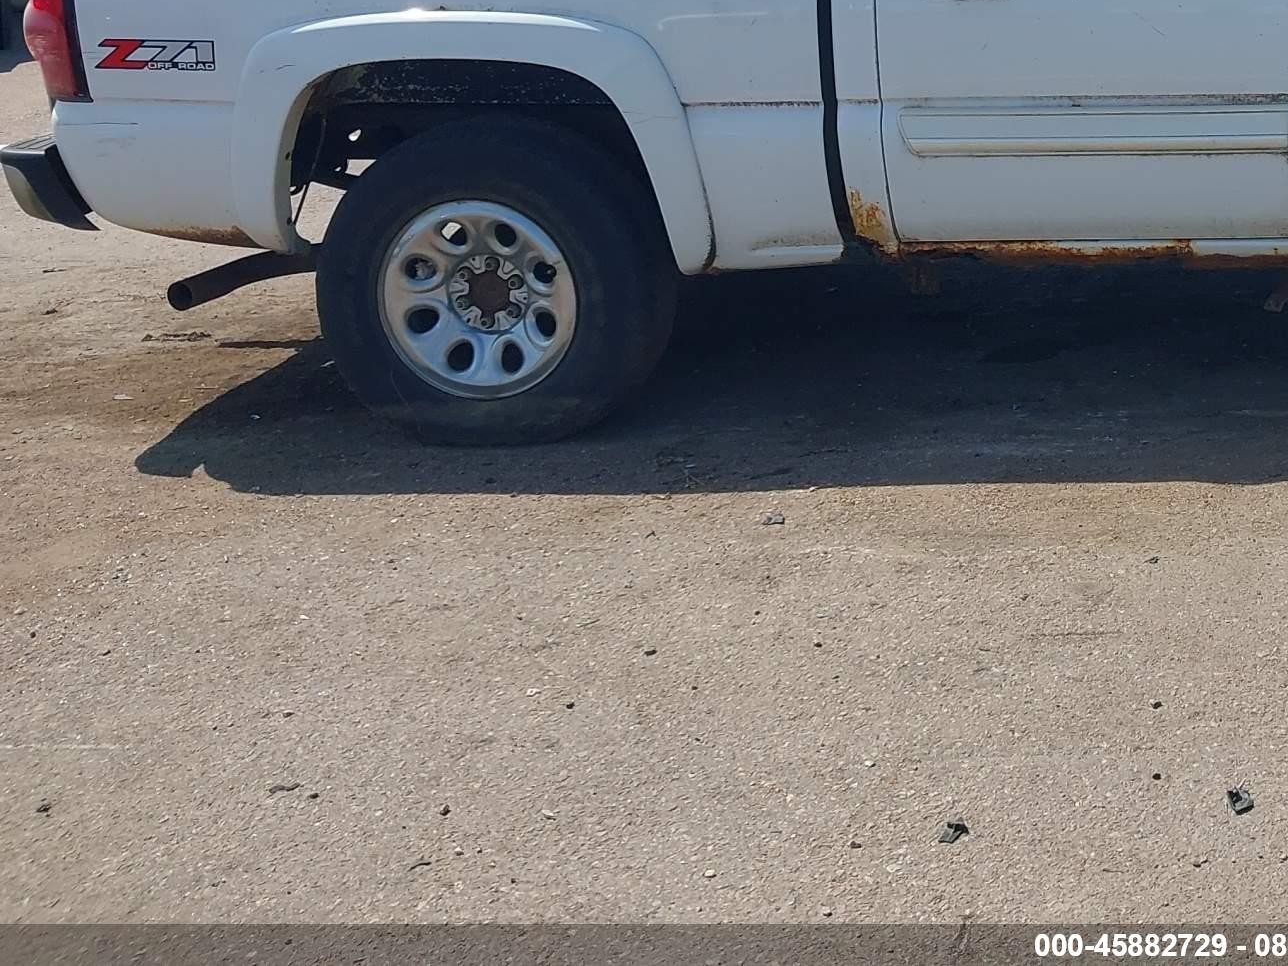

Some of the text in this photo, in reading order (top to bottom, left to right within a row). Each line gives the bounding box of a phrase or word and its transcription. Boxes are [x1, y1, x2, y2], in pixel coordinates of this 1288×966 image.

[95, 39, 215, 69] Z71
[148, 62, 214, 70] OFF ROAD
